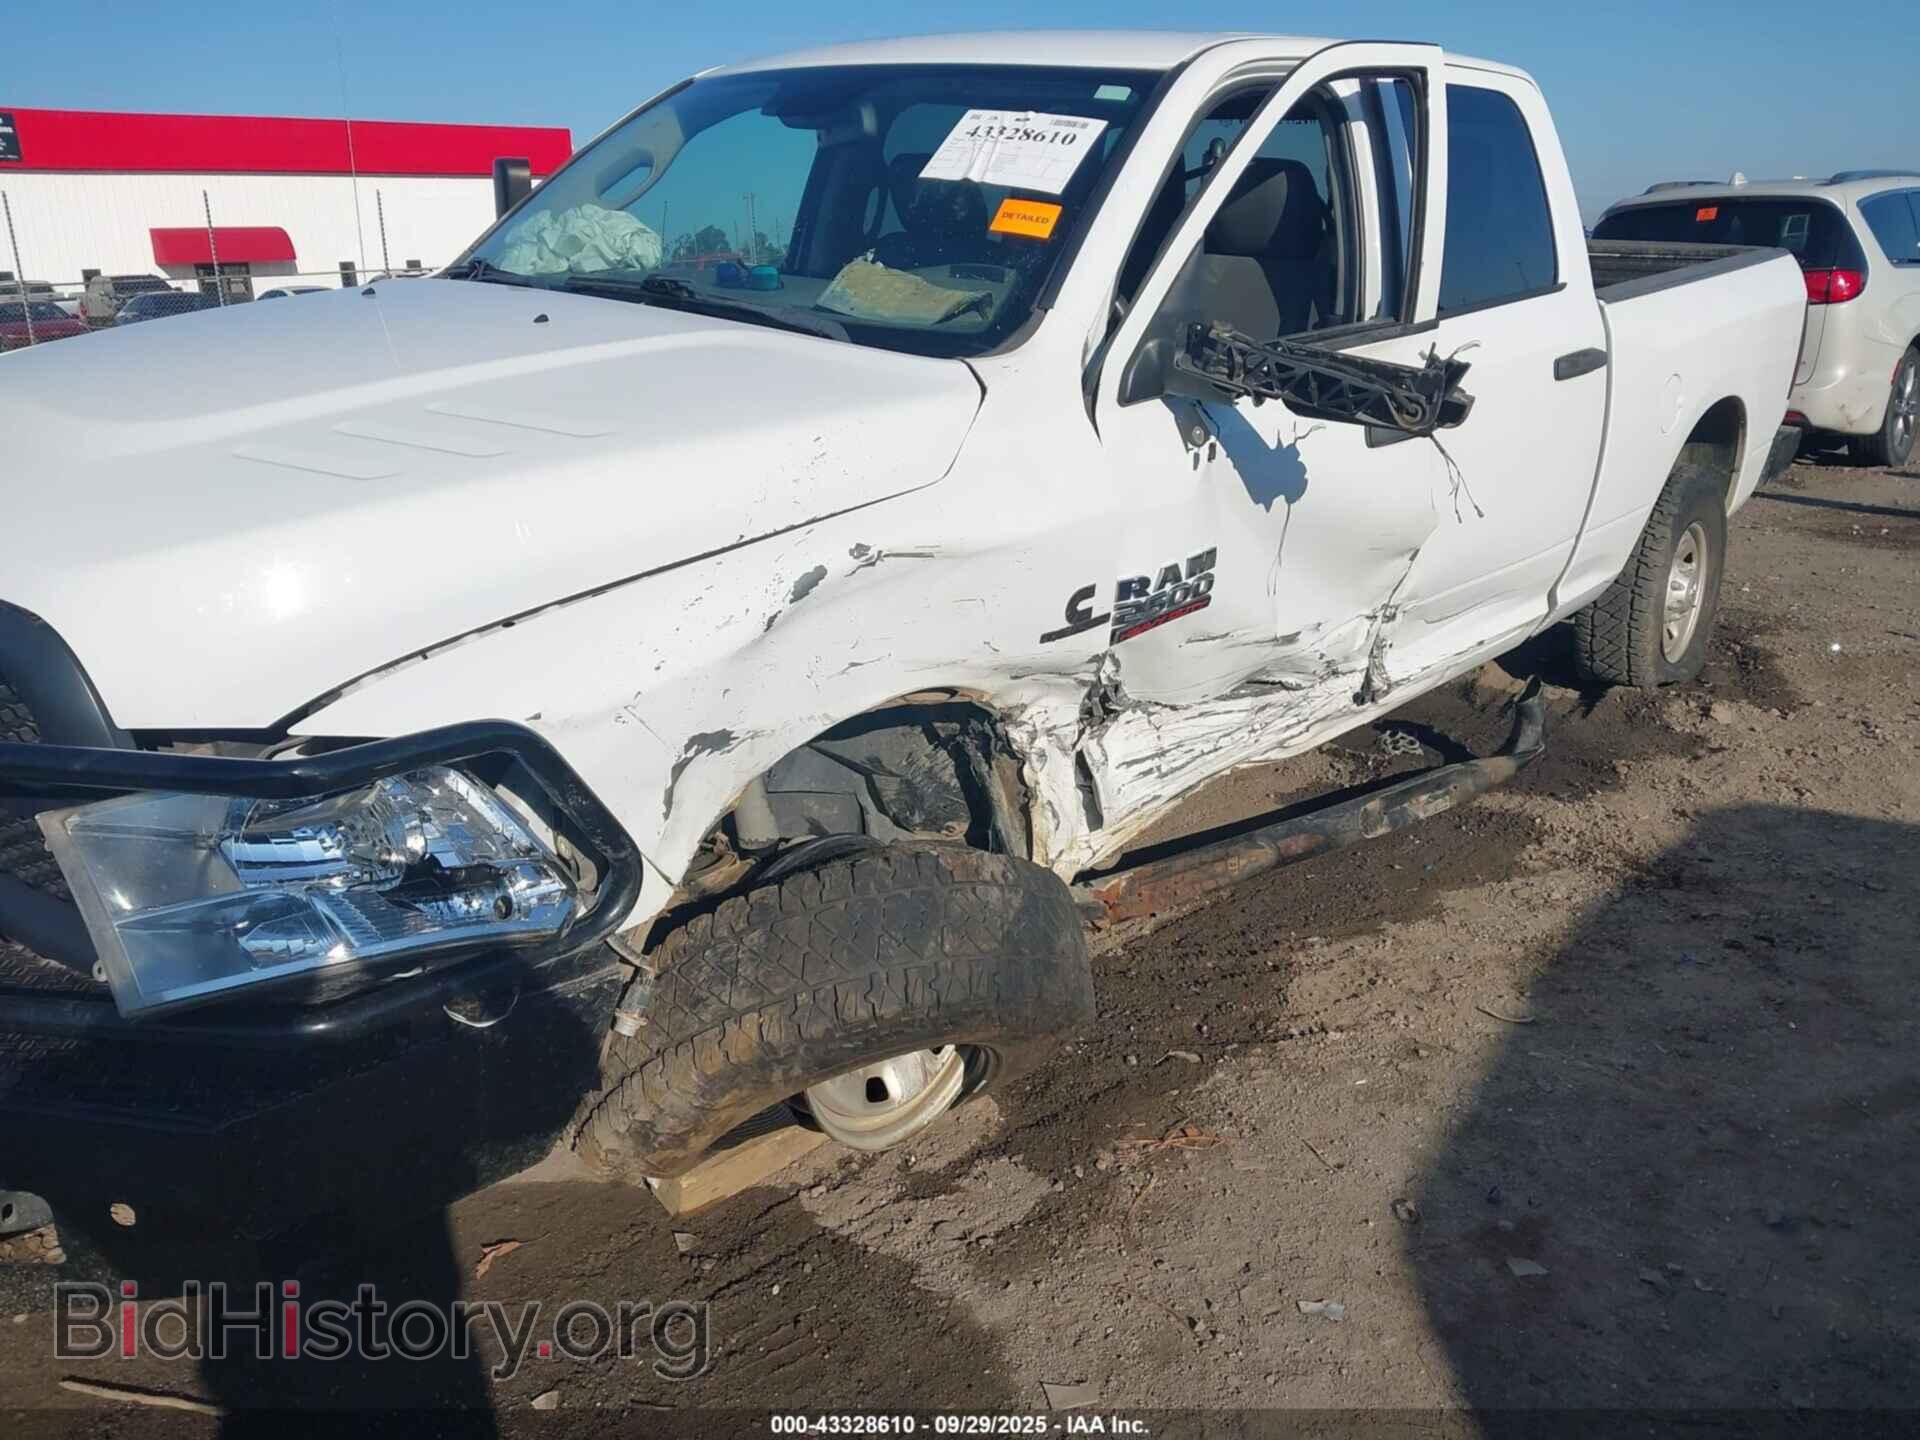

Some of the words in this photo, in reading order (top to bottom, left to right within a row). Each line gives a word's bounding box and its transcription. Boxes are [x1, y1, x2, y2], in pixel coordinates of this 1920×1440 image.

[966, 124, 1077, 146] 43328610
[1001, 210, 1050, 225] DETAILED
[1115, 547, 1217, 602] RAM
